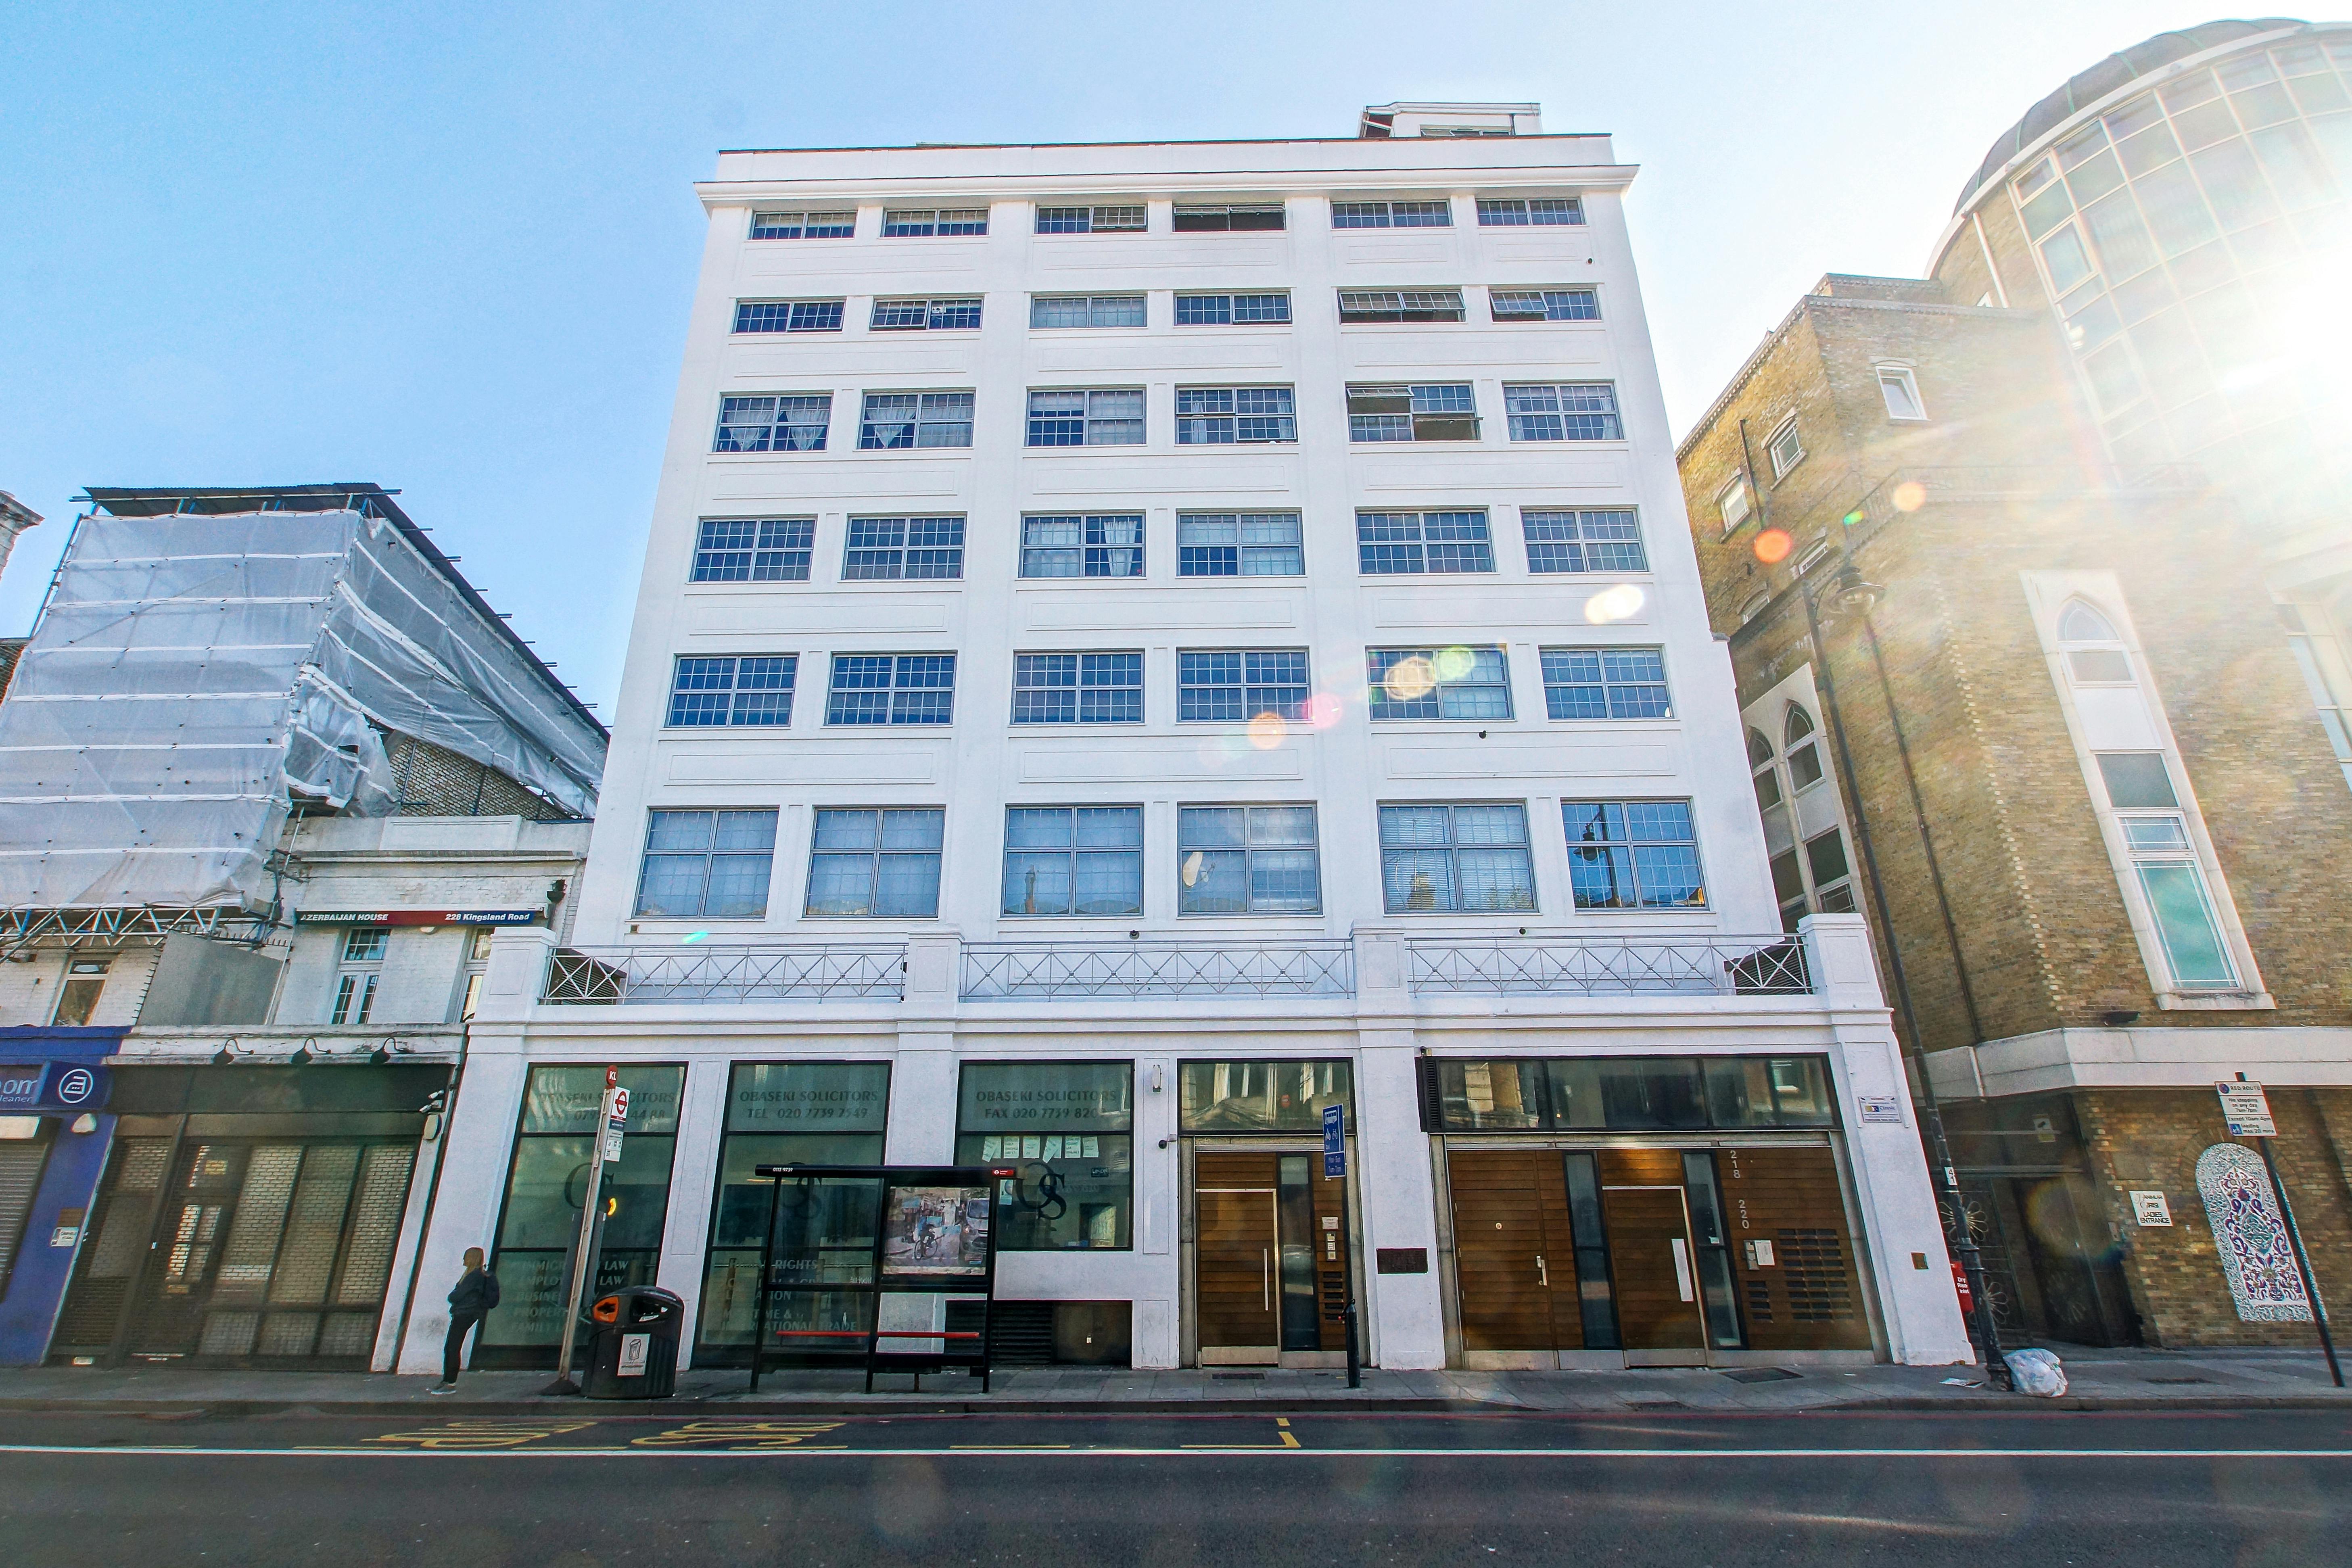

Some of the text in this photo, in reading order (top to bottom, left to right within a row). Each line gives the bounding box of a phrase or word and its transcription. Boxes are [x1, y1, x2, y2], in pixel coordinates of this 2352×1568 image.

[464, 913, 506, 922] Kingsland
[609, 1071, 616, 1081] KL
[0, 1079, 38, 1094] om
[739, 1091, 877, 1101] OBASEKI SOLICITORS
[976, 1091, 1116, 1101] OBASEKI SOLICITORS
[747, 1109, 768, 1118] TEL
[777, 1109, 801, 1118] 020
[807, 1108, 834, 1118] 7739
[984, 1109, 1008, 1118] FAX
[1013, 1109, 1036, 1118] 020
[1042, 1109, 1069, 1118] 7739
[604, 1261, 629, 1270] LAW
[775, 1259, 818, 1269] RIGHTS
[599, 1276, 624, 1286] LAW
